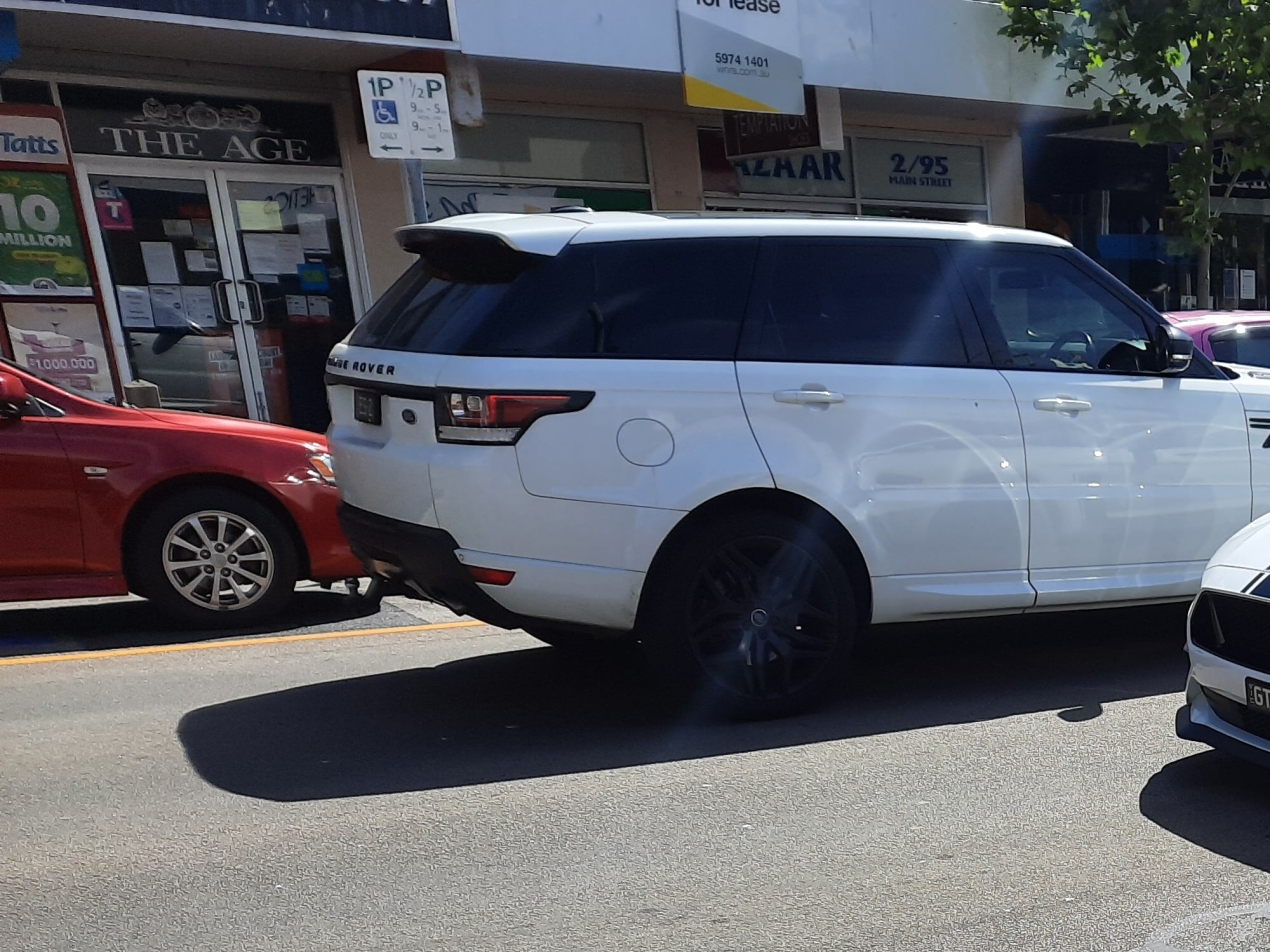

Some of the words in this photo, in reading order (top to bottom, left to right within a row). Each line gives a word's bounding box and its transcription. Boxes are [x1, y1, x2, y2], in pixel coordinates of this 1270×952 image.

[715, 52, 741, 65] 5974
[745, 55, 769, 68] 1401
[368, 77, 394, 97] 1P
[0, 131, 60, 155] Tatts
[100, 127, 203, 157] THE
[221, 135, 311, 162] AGE
[890, 153, 949, 176] 2/95
[889, 175, 917, 187] MAIN
[919, 177, 953, 188] STREET
[0, 232, 73, 248] MILLION
[352, 361, 396, 376] ROVER
